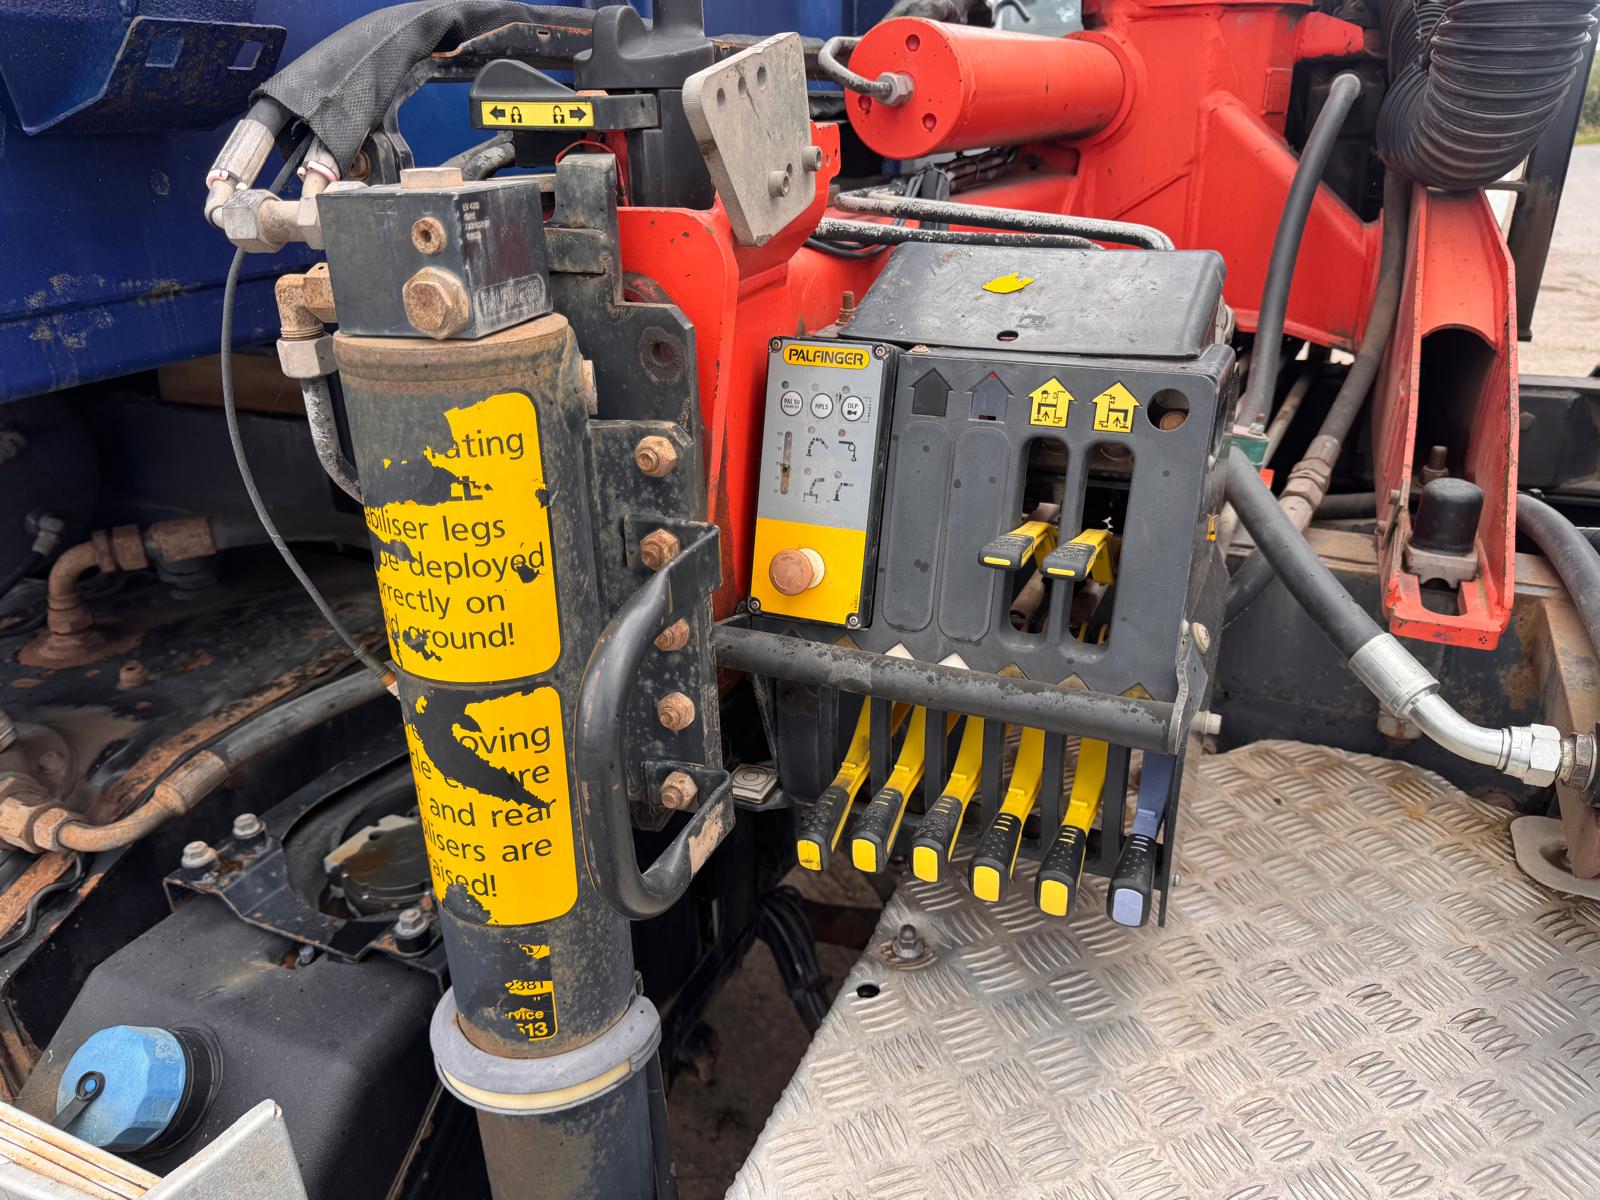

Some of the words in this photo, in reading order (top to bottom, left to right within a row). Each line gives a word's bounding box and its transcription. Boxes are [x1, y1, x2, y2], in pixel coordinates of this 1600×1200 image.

[788, 348, 864, 366] PALFINGER
[847, 402, 859, 410] OLP
[432, 429, 524, 460] ating
[442, 515, 506, 547] legs
[409, 541, 545, 585] deployed
[466, 594, 505, 614] on
[429, 797, 477, 827] and
[491, 797, 557, 828] rear
[502, 838, 553, 863] are
